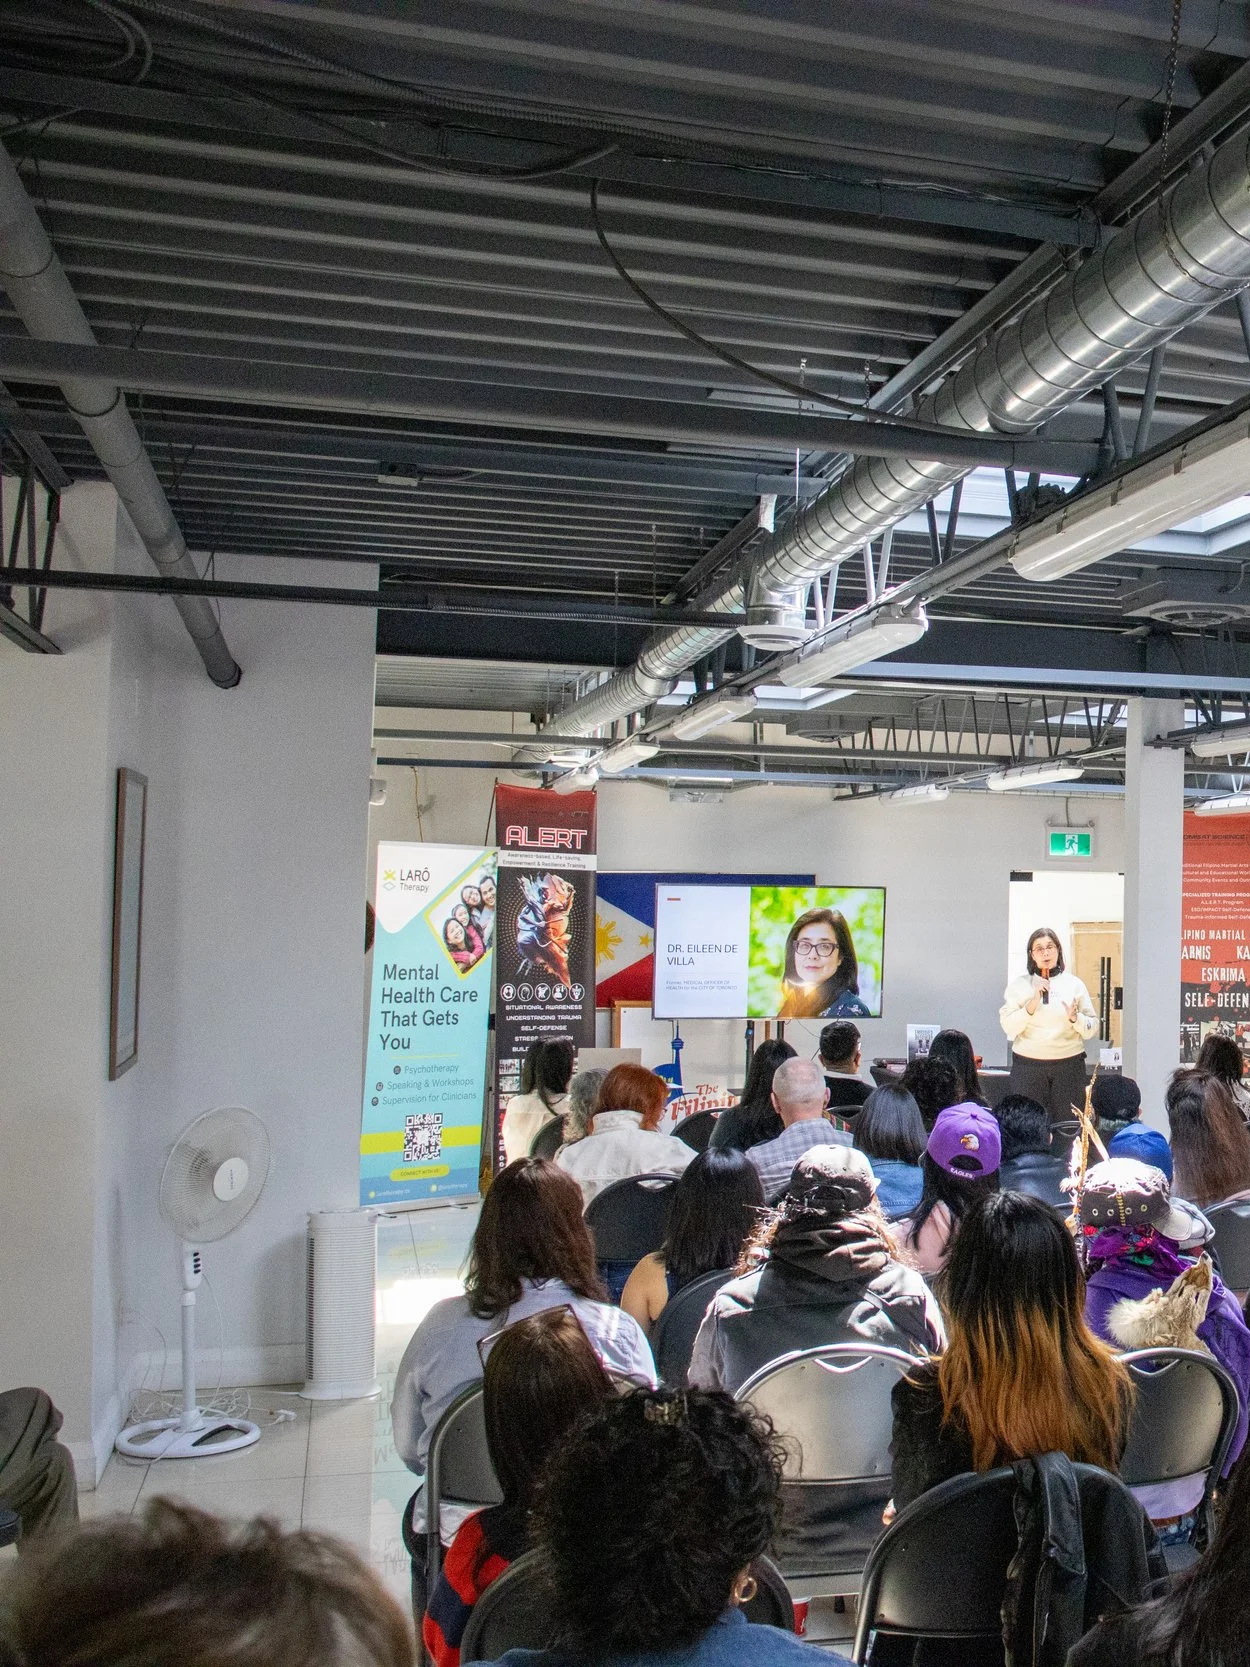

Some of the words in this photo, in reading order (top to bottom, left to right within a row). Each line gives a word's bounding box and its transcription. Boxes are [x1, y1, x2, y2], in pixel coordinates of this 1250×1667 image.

[505, 825, 588, 850] ALERT
[502, 859, 536, 867] Empowerment
[400, 867, 430, 882] LARÔ
[400, 882, 429, 893] Therapy
[1209, 929, 1246, 941] MARTIAL
[667, 944, 684, 953] DR.
[687, 944, 722, 953] EILEEN
[724, 944, 738, 953] DE
[1181, 945, 1211, 960] ARNIS
[667, 956, 695, 966] VILLA
[383, 964, 439, 980] Mental
[1201, 967, 1246, 982] ESKRIMA
[381, 987, 435, 1004] Health
[440, 986, 478, 1003] Care
[381, 1010, 417, 1027] That
[423, 1009, 459, 1026] Gets
[380, 1034, 411, 1050] You
[404, 1065, 459, 1075] Psychotherapy
[387, 1080, 422, 1091] Speaking
[424, 1080, 430, 1088] &
[431, 1078, 474, 1088] Workshops
[696, 1084, 718, 1096] The
[382, 1095, 427, 1106] Supervision
[428, 1094, 439, 1102] for
[441, 1091, 477, 1102] Clinicians
[950, 1167, 974, 1179] EAGLES
